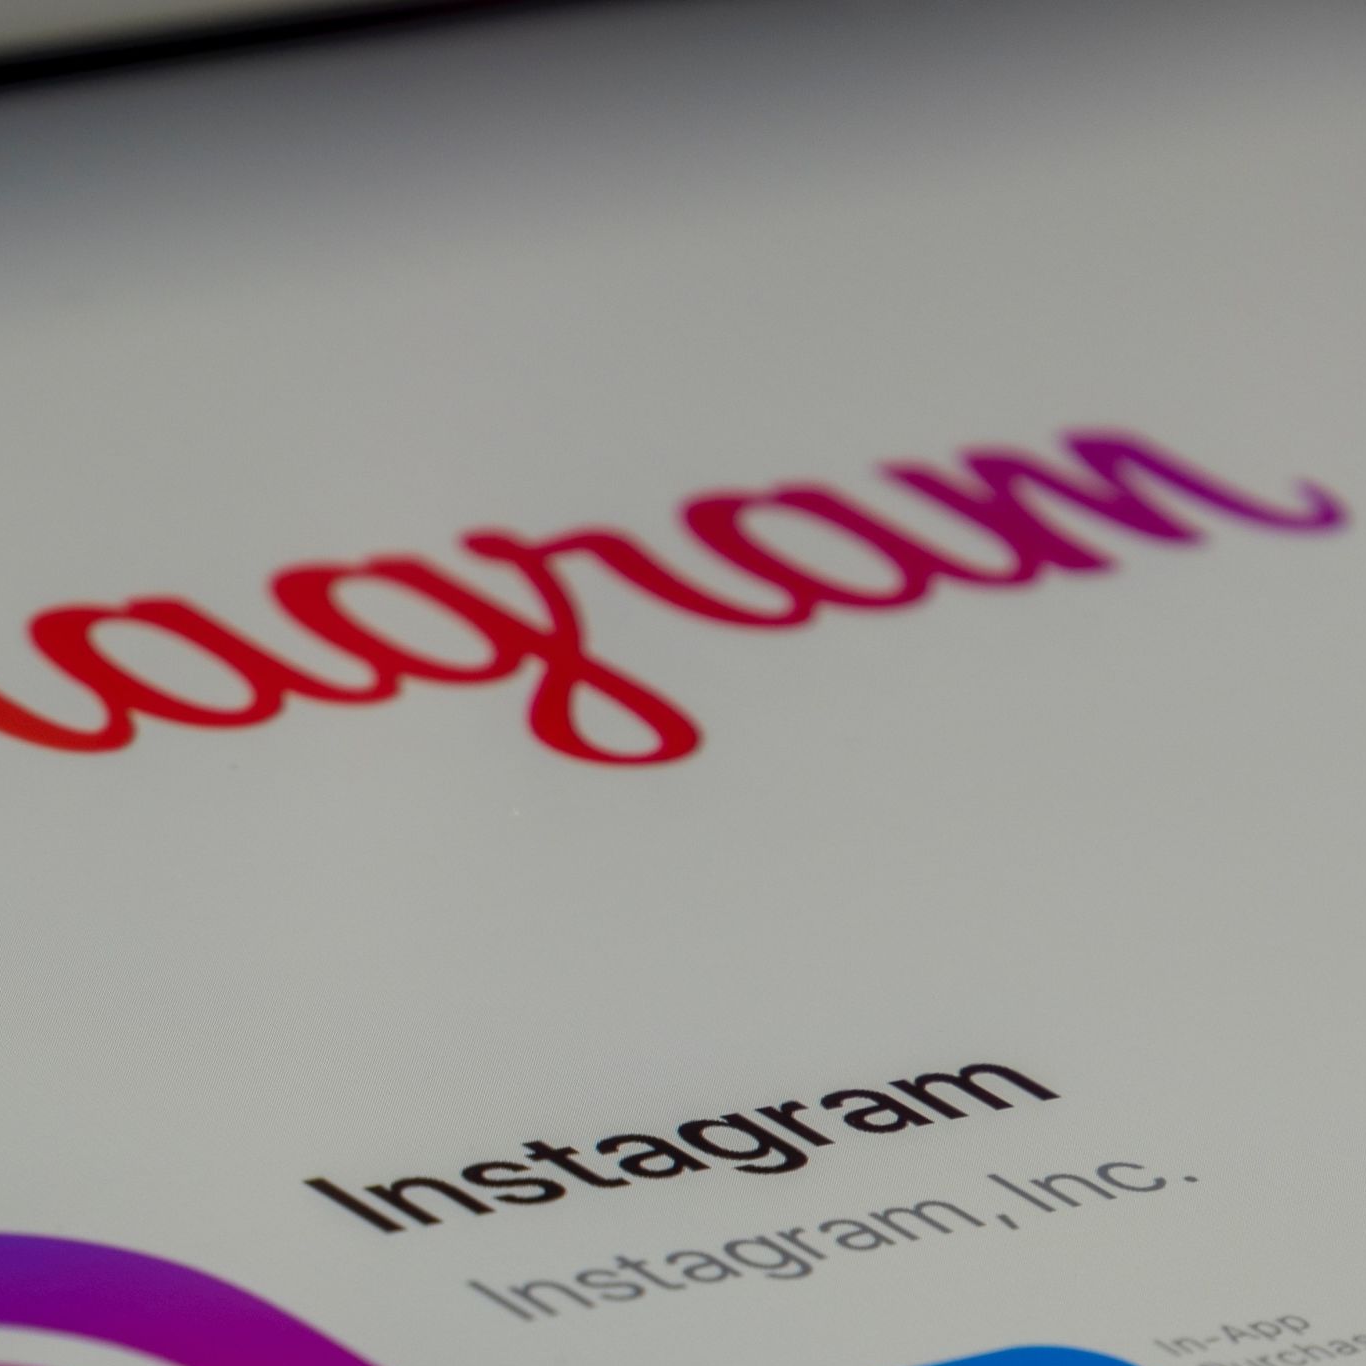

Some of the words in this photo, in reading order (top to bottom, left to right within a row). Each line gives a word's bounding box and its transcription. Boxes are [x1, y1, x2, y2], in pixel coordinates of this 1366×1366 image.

[302, 1062, 1062, 1235] Instagram
[985, 1159, 1200, 1215] Inc.
[1152, 1313, 1312, 1359] In-App
